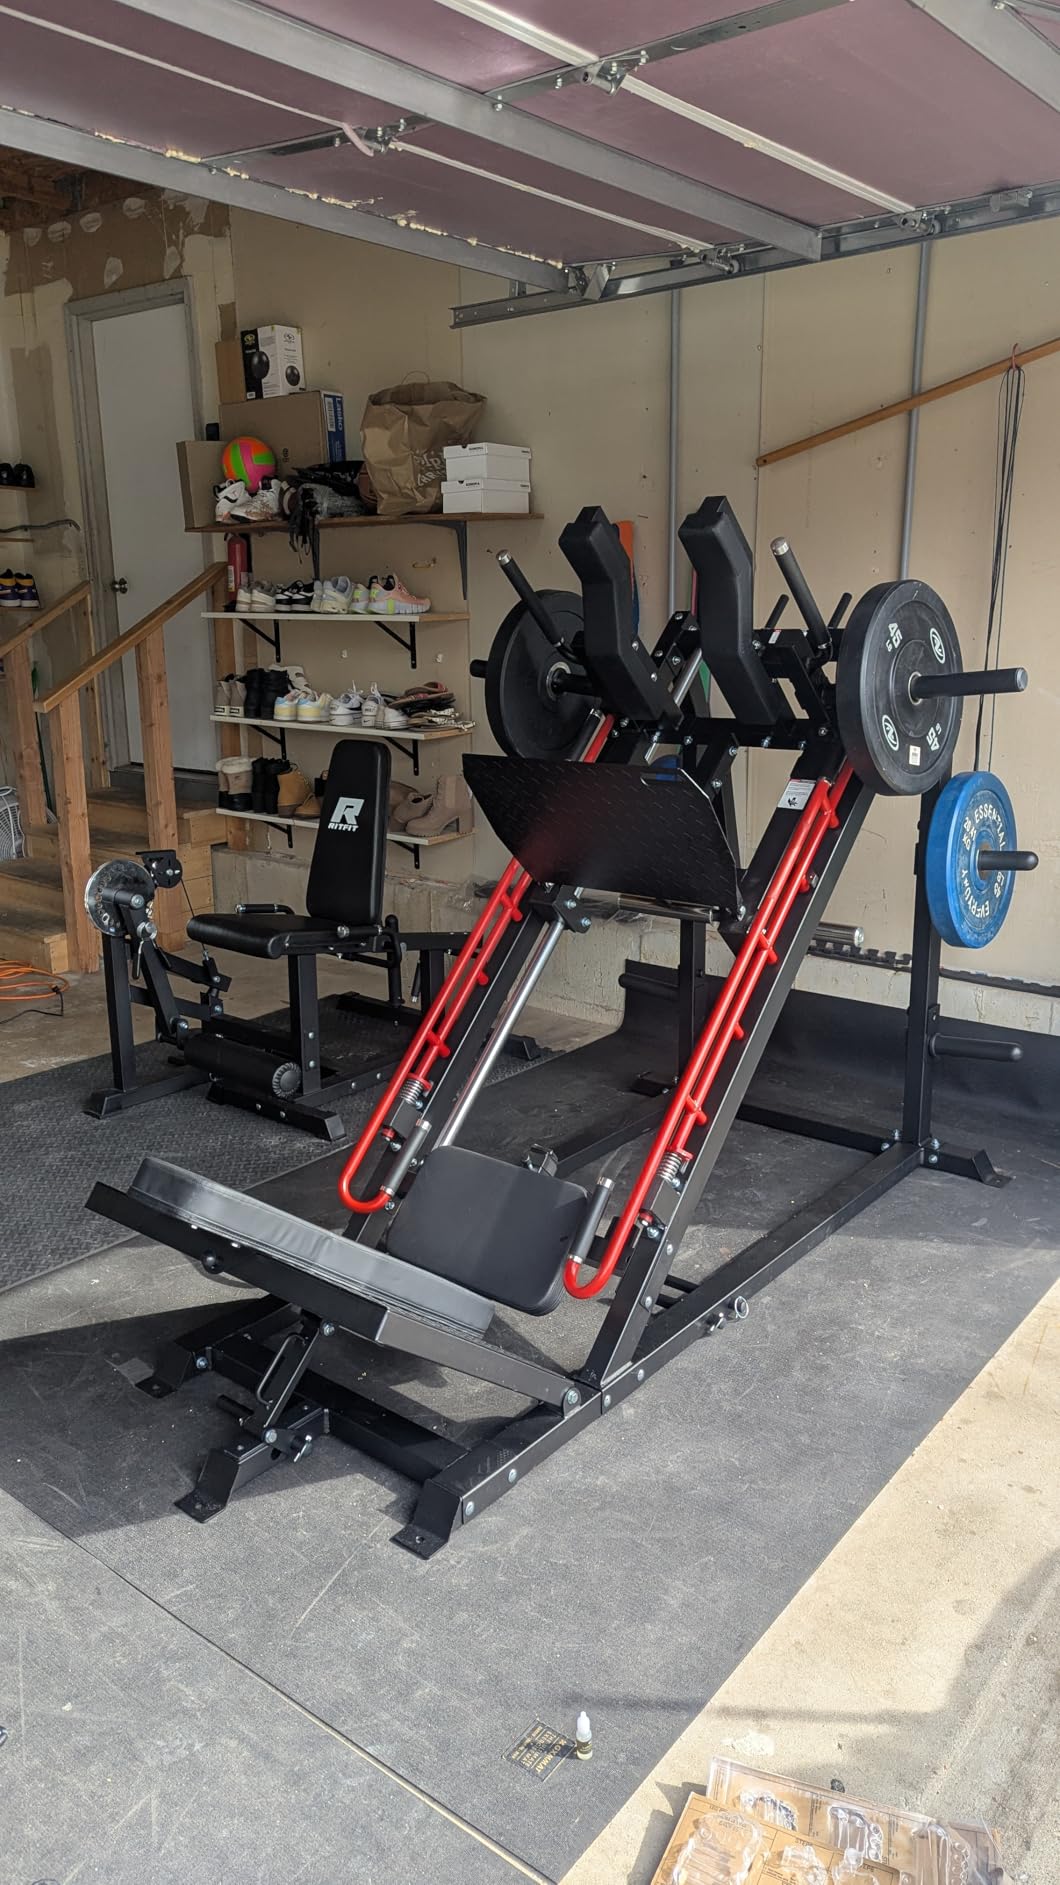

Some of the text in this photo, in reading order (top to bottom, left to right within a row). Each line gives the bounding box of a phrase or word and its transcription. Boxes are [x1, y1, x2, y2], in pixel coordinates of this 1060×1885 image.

[888, 622, 903, 649] 45
[926, 726, 940, 751] 45
[327, 822, 359, 832] RITFIT
[974, 803, 1006, 851] ESSENTIAL
